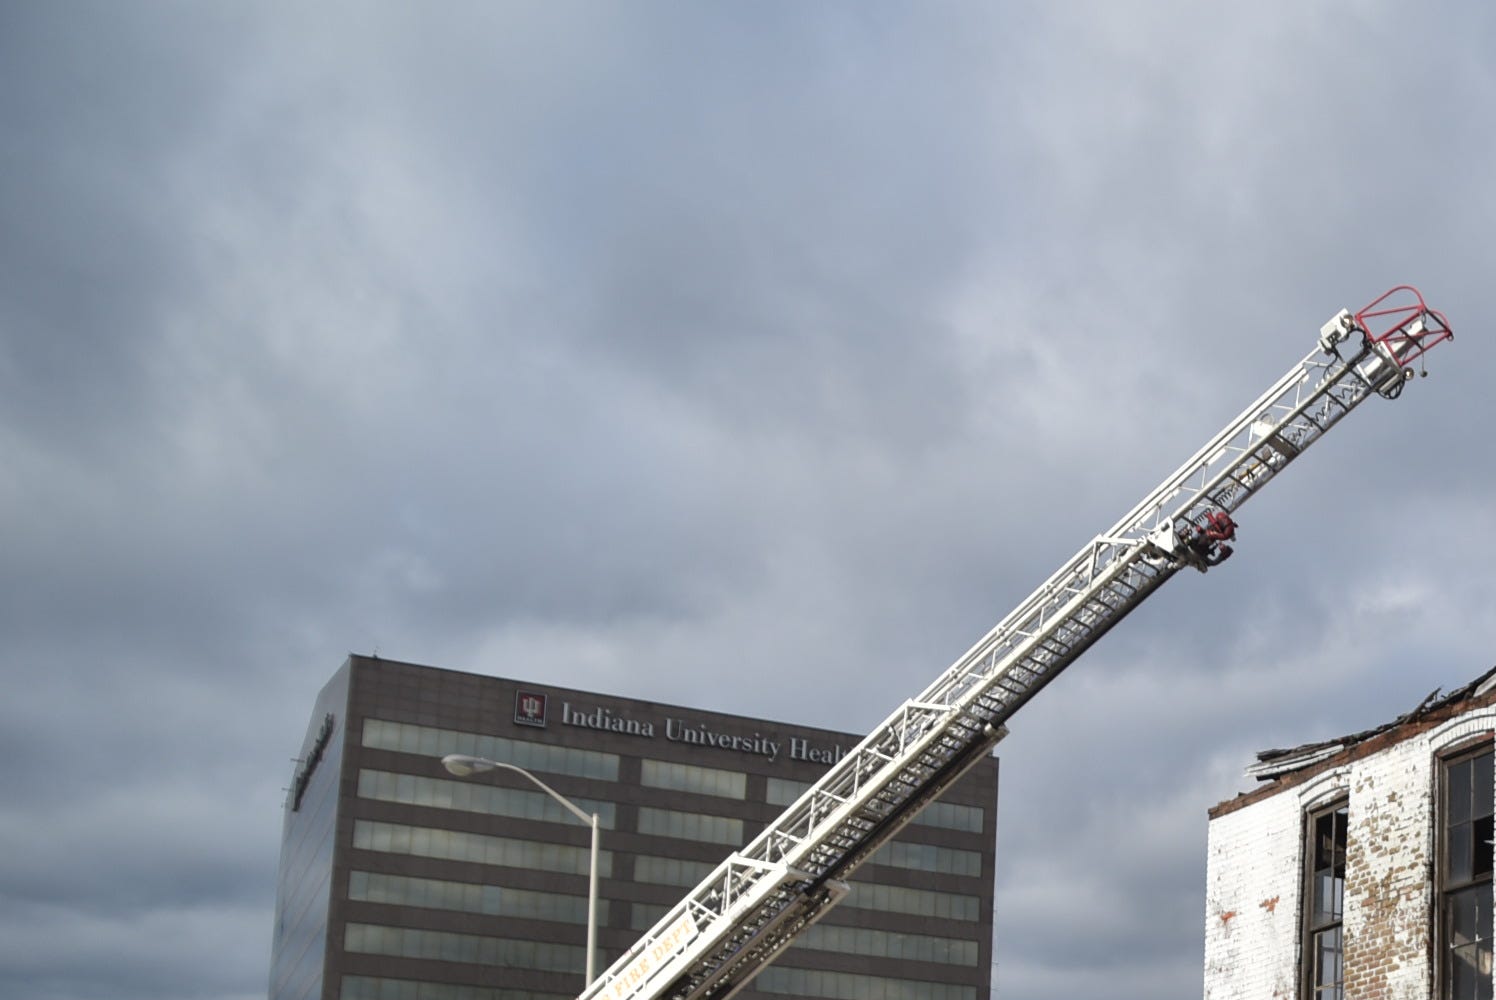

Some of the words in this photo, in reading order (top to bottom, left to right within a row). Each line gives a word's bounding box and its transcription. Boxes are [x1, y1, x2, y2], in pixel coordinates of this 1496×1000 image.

[562, 702, 654, 737] Indiana
[665, 718, 780, 762] University
[790, 737, 848, 765] Healt
[613, 957, 650, 998] FIRE
[651, 919, 692, 962] DEPT
